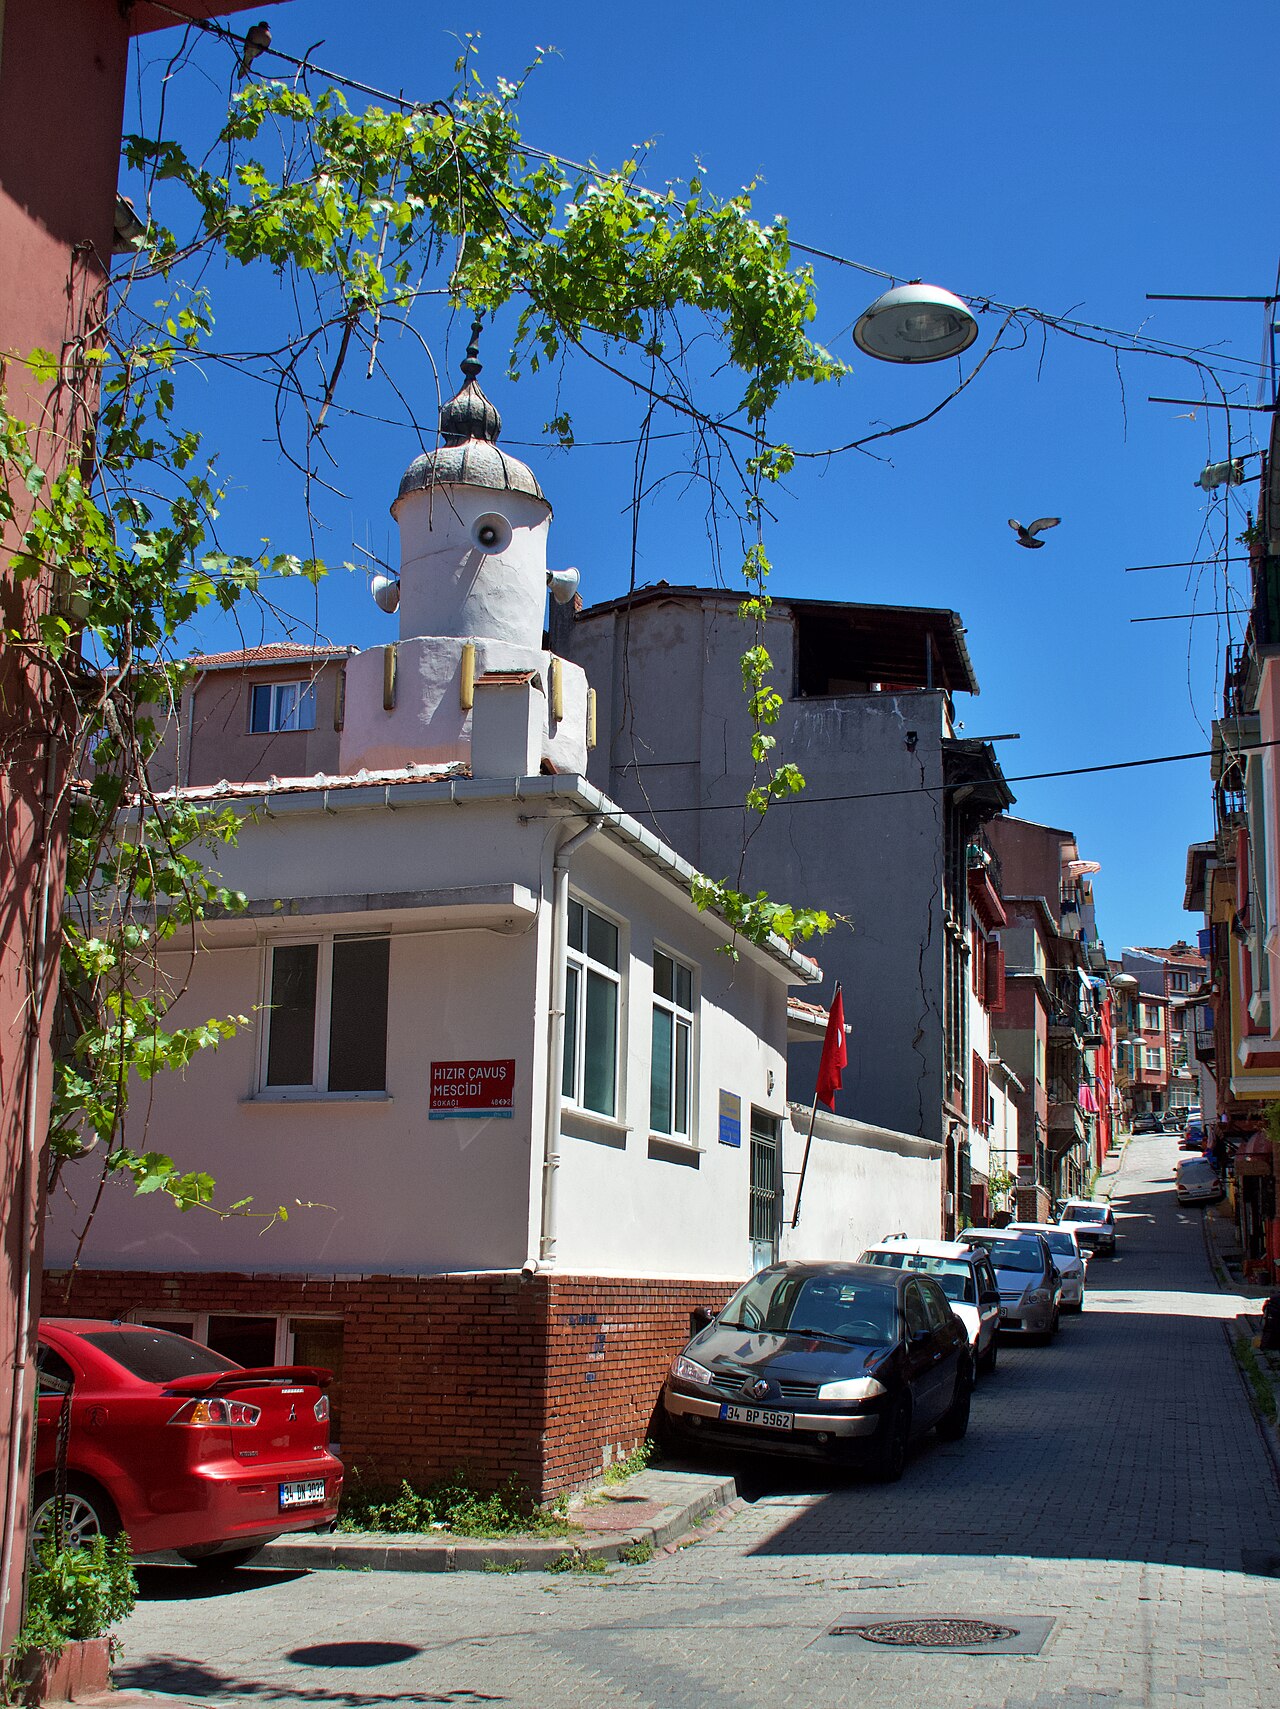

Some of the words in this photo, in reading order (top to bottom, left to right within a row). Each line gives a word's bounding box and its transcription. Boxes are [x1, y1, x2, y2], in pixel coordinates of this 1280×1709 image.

[434, 1068, 465, 1080] HIZIR
[468, 1066, 506, 1081] ÇAVUŞ
[433, 1081, 482, 1096] MESCİDİ
[727, 1406, 740, 1420] 34
[745, 1409, 760, 1423] BP
[762, 1412, 790, 1427] 5962
[285, 1485, 294, 1501] 34
[297, 1484, 306, 1500] DN
